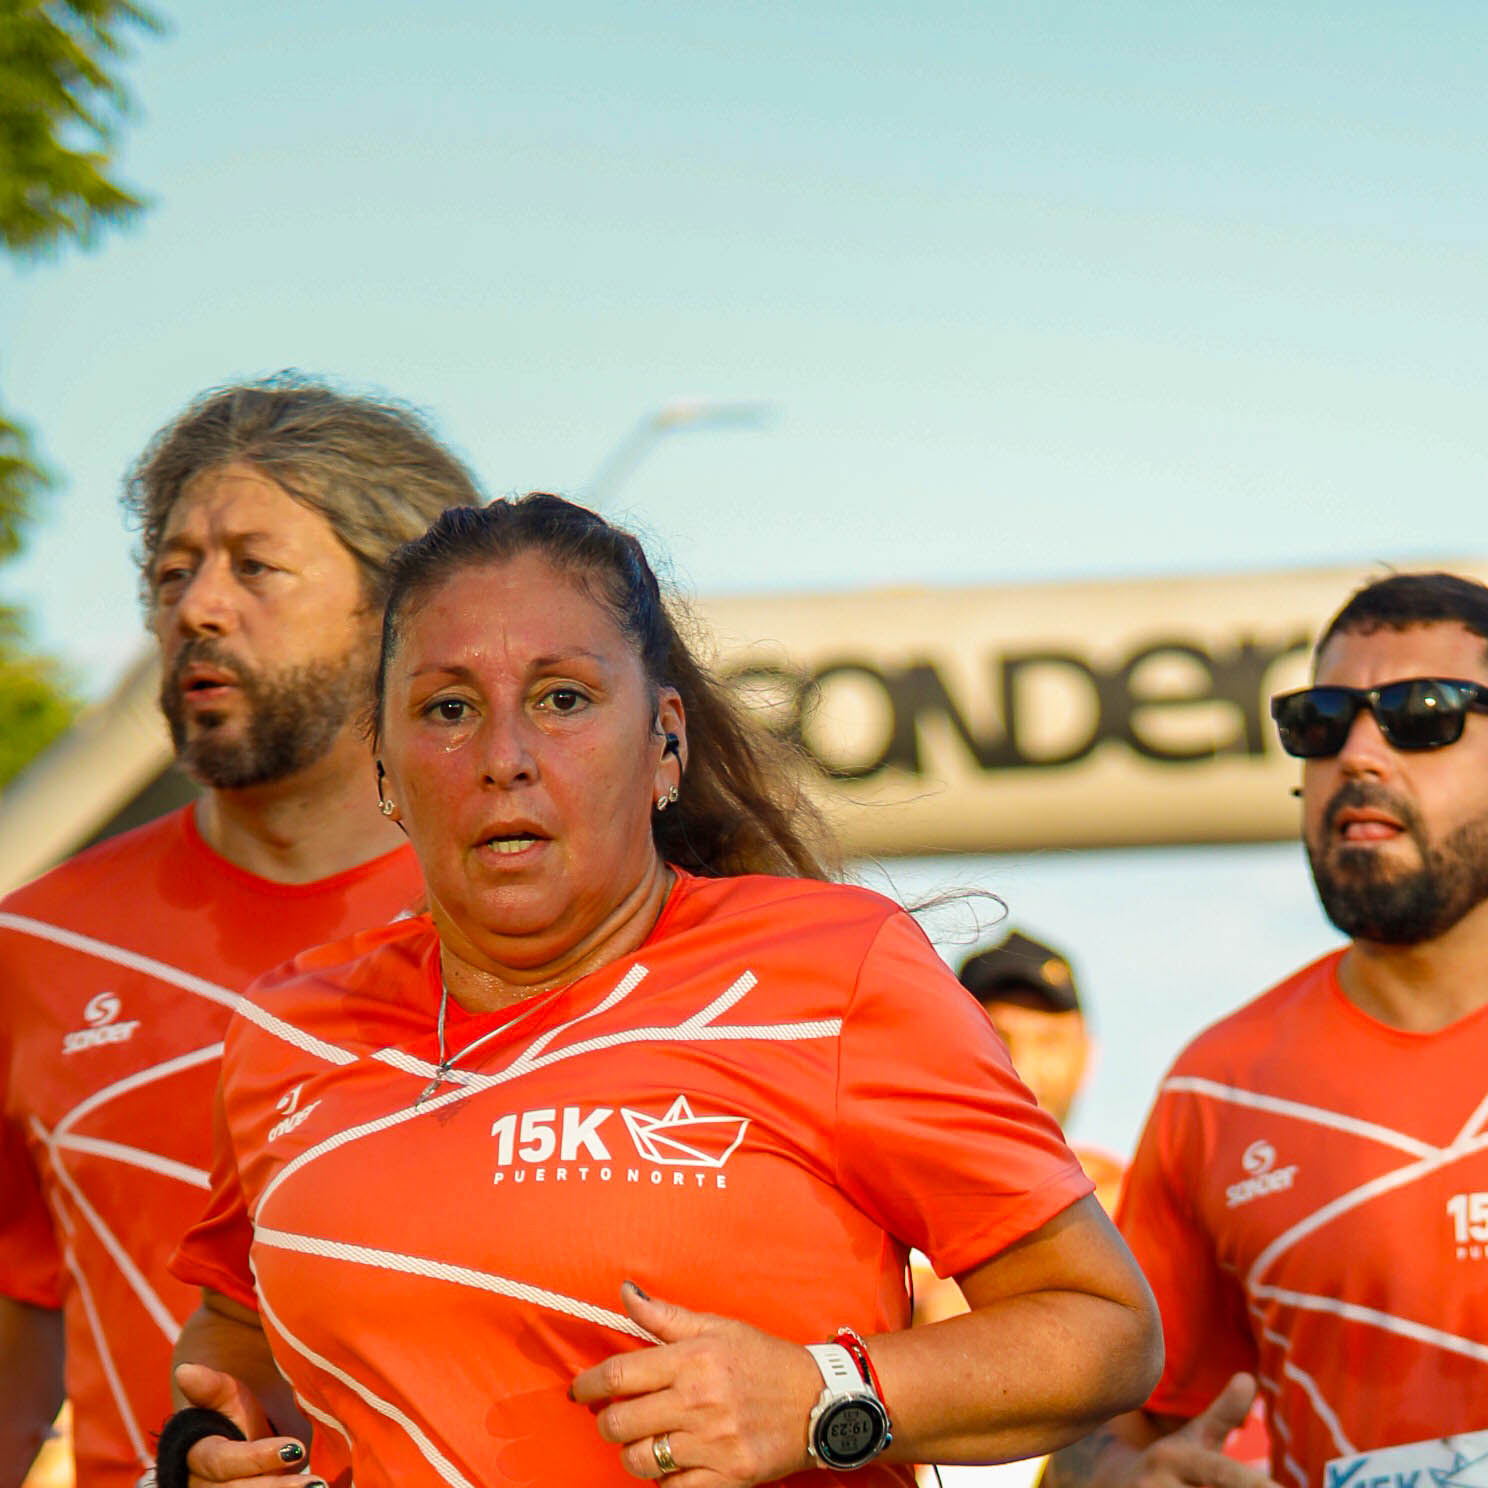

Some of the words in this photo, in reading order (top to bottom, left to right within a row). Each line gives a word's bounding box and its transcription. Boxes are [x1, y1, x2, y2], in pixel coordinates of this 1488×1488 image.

[491, 1107, 614, 1166] 15K
[493, 1167, 612, 1185] PUERTO
[627, 1168, 727, 1189] NORTE
